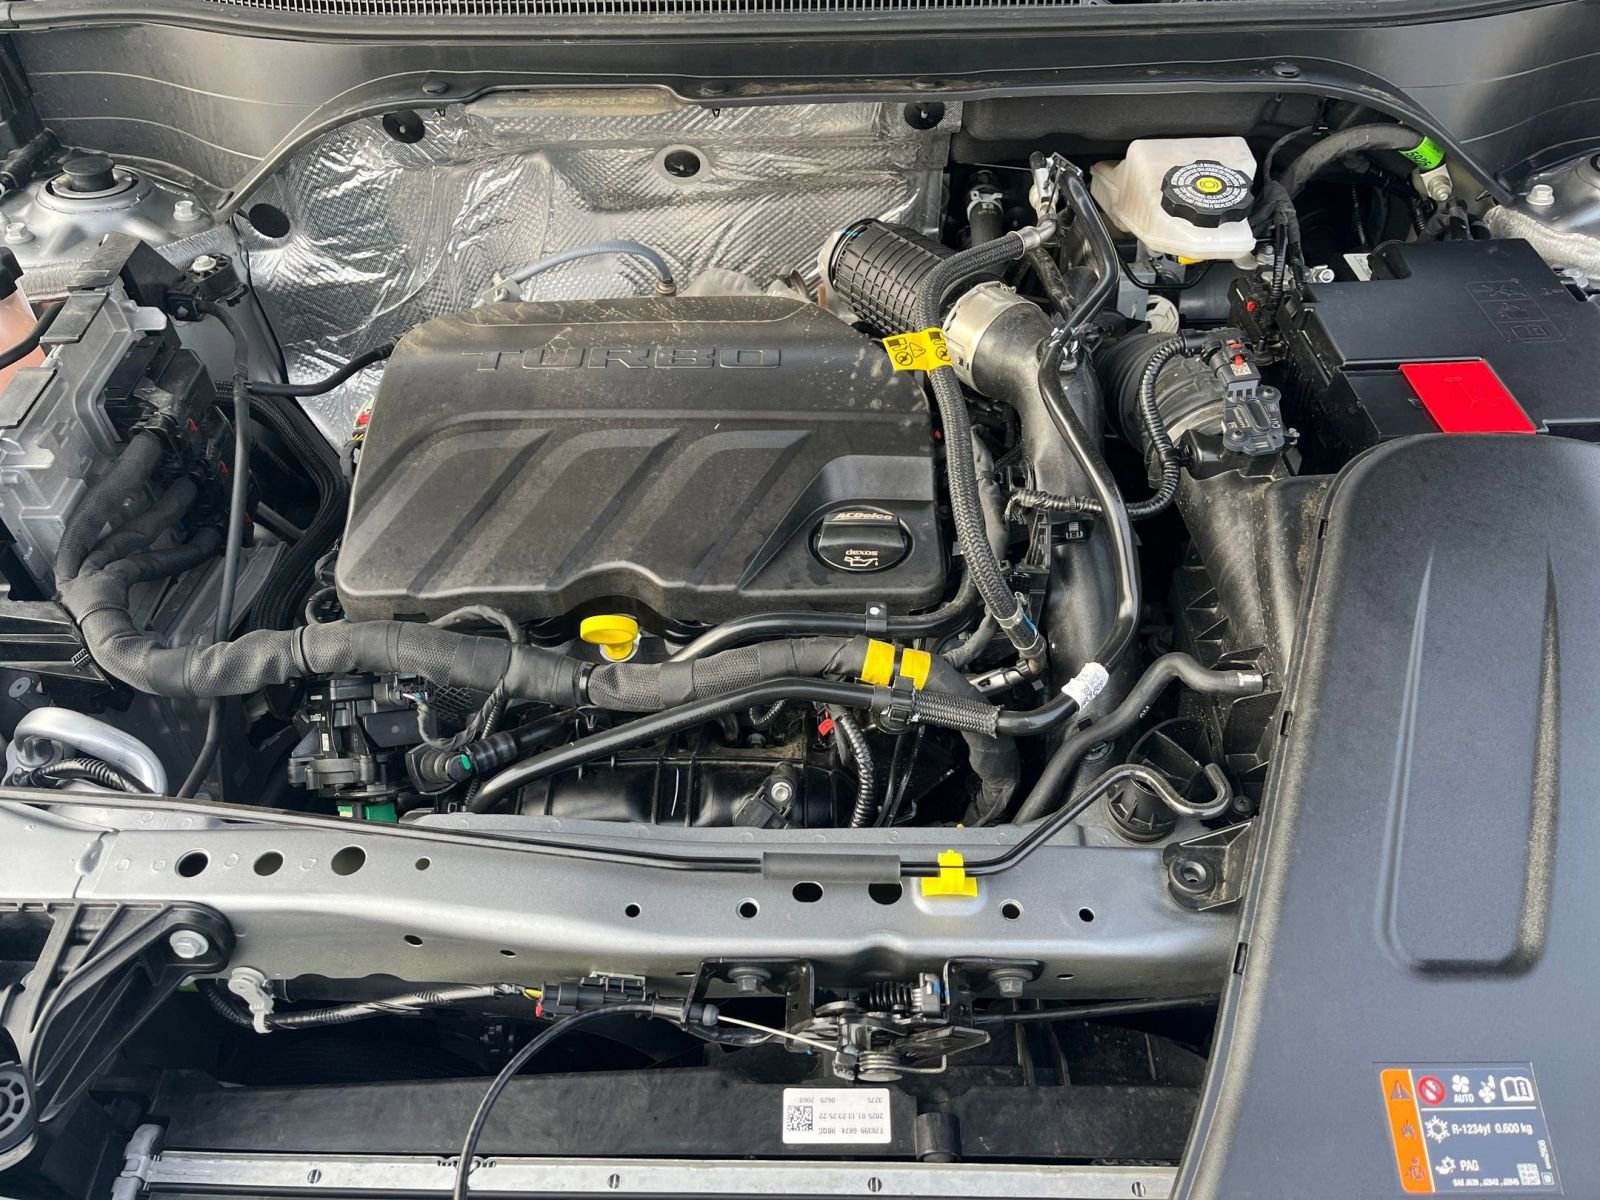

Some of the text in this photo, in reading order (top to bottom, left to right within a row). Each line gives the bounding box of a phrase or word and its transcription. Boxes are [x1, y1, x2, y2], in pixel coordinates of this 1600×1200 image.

[461, 348, 782, 371] TURBO
[832, 512, 893, 521] ACDelco
[1453, 1094, 1474, 1103] AUTO
[1451, 1122, 1533, 1136] R-1234yf 0.600 kg
[1459, 1159, 1480, 1172] PAG
